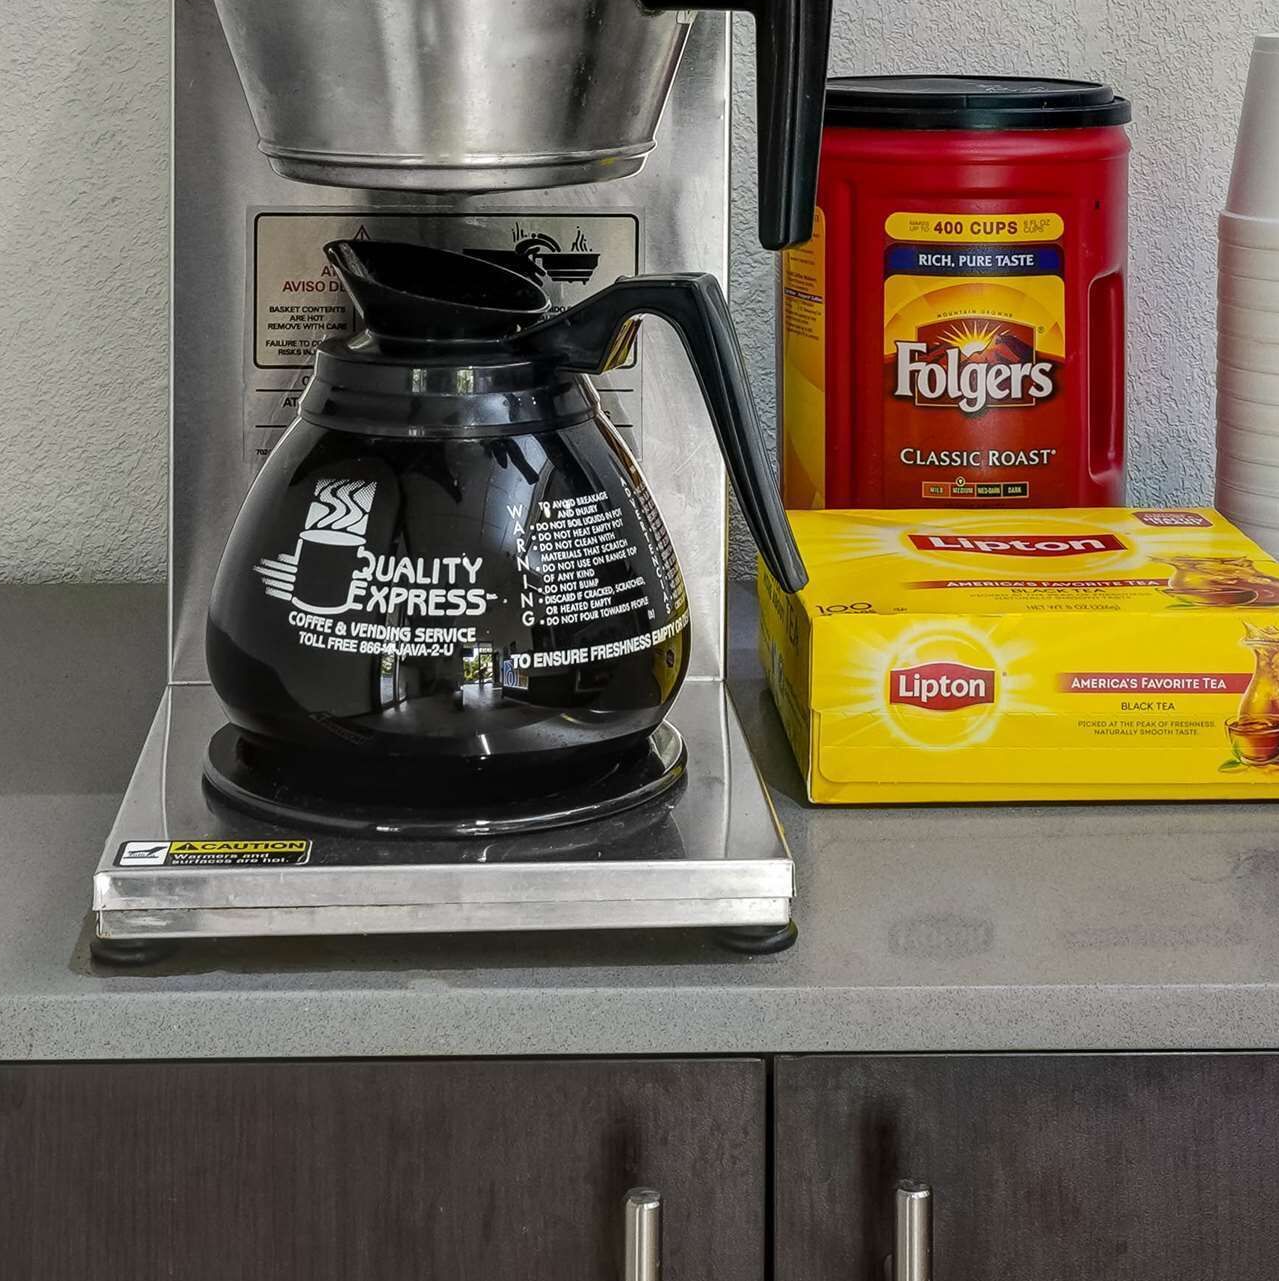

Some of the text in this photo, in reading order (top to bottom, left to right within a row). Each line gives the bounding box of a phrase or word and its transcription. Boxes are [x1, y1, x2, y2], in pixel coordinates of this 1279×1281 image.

[933, 221, 1018, 235] 400 CUPS
[959, 254, 993, 267] PURE
[995, 254, 1034, 266] TASTE
[282, 280, 325, 293] AVISO
[289, 314, 324, 322] ARE HOT
[894, 341, 1054, 413] Folgers
[900, 448, 980, 466] CLASSIC
[538, 491, 609, 511] TO AVOID BREAKAGE
[536, 522, 549, 531] DO
[550, 520, 566, 530] NOT
[567, 518, 582, 528] BOIL
[605, 511, 613, 521] IN
[557, 509, 575, 519] AND
[538, 519, 624, 541] DO NOT HEAT EMPTY POT
[540, 531, 616, 552] DO NOT CLEAN WITH
[541, 539, 629, 563] MATERIALS THAT SCRATCH
[928, 536, 1106, 552] Lipton
[352, 546, 484, 585] QUALITY
[506, 504, 536, 627] WARNING
[542, 546, 638, 573] DO NOT USE ON RANGE TOP
[543, 568, 595, 584] OF ANY KIND
[544, 578, 599, 594] DO NOT BUMP
[347, 580, 487, 617] EXPRESS
[545, 592, 577, 605] DISCARD
[577, 591, 583, 600] IF
[584, 585, 615, 599] CRACKED,
[546, 597, 612, 615] OR HEATED EMPTY
[546, 616, 560, 626] DO
[561, 613, 579, 625] NOT
[600, 604, 631, 619] TOWARDS
[816, 602, 872, 613] 100
[288, 611, 476, 643] COFFEE & VENDING SERVICE
[298, 631, 325, 649] TOLL
[327, 637, 358, 653] FREE
[511, 622, 675, 669] TO ENSURE FRESHNESS EMPTY
[899, 673, 985, 702] Lipton
[1071, 677, 1227, 689] AMERICA'S FAVORITE TEA
[1120, 702, 1175, 711] BLACK TEA
[201, 842, 304, 850] CAUTION
